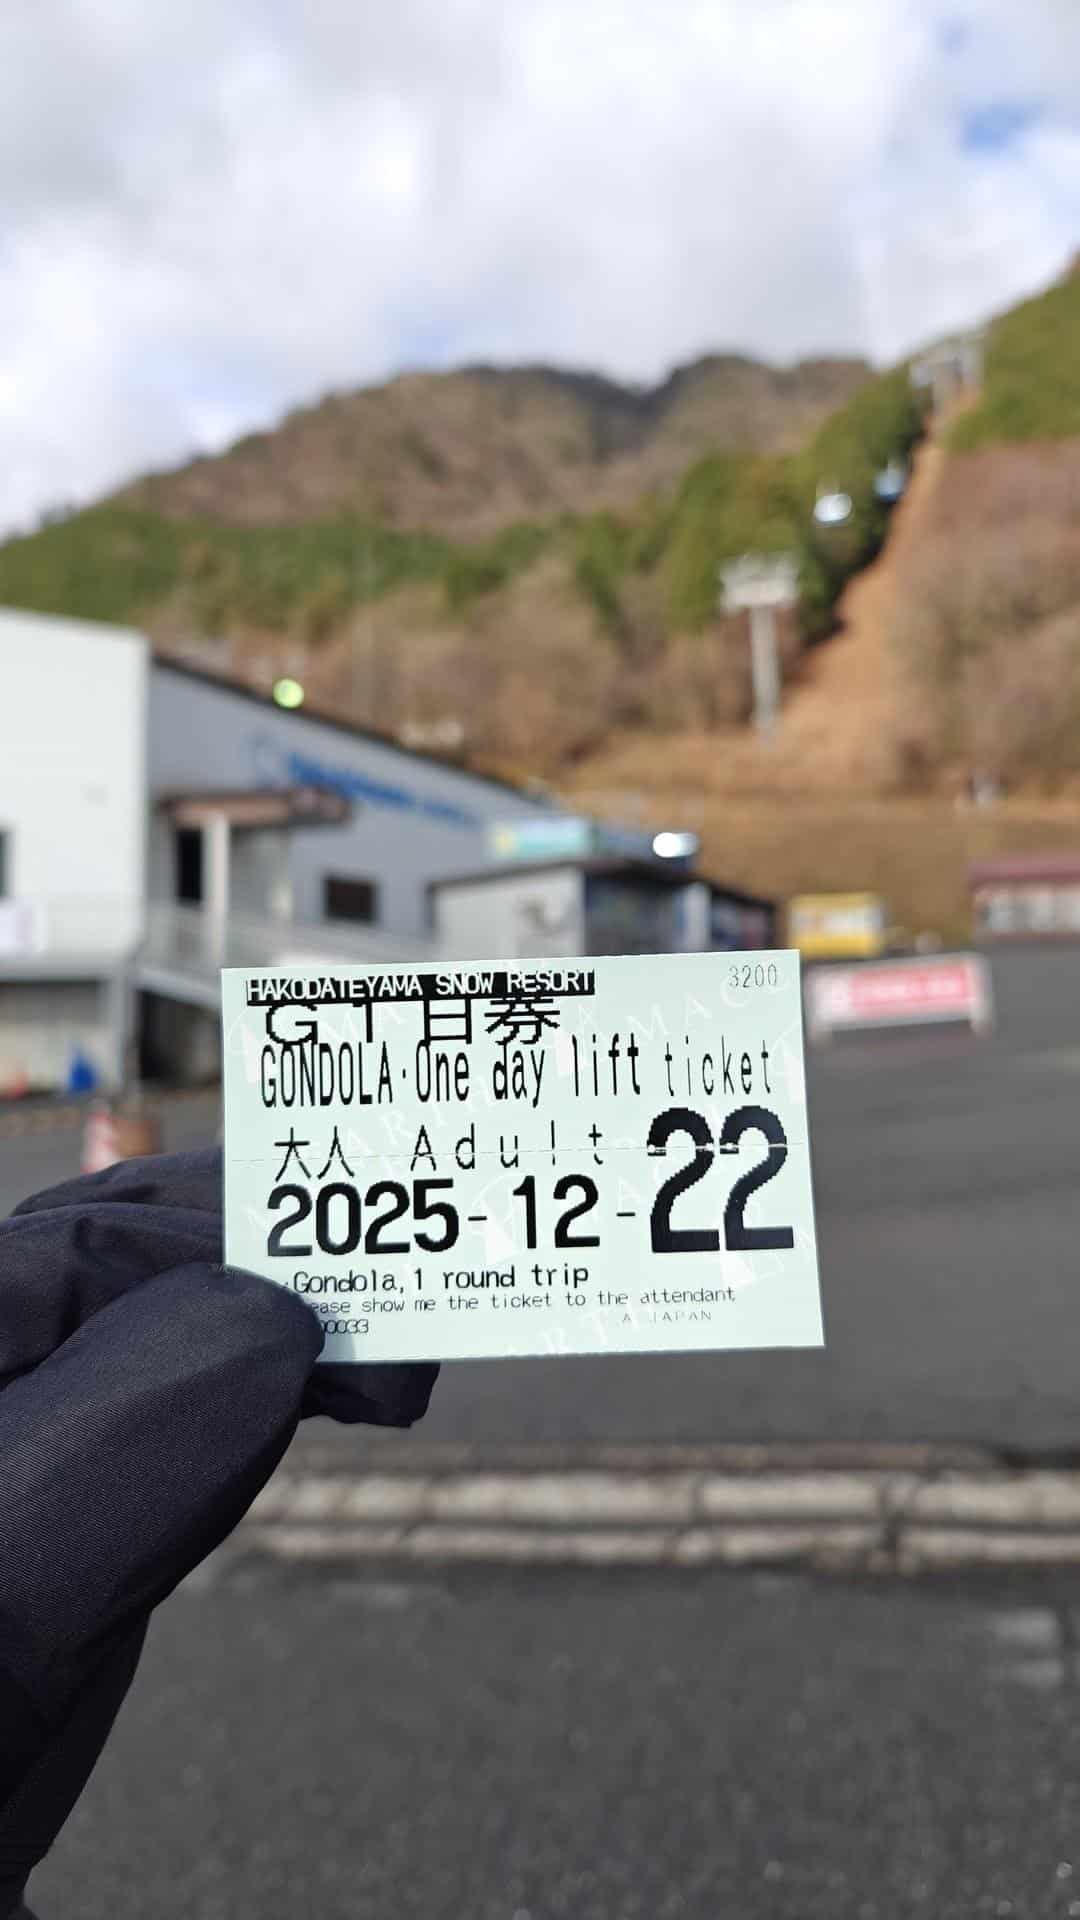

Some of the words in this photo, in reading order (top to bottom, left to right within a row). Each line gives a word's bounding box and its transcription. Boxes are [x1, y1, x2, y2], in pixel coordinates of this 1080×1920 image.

[248, 976, 423, 1001] HAKODATEYAMA
[435, 972, 494, 995] SNOW
[506, 970, 592, 993] RESORT
[729, 963, 778, 989] 3200
[492, 1040, 545, 1108] day
[571, 1032, 641, 1097] lift
[664, 1034, 771, 1097] ticket
[273, 1125, 355, 1183] 大人
[410, 1120, 604, 1172] Adult
[442, 1264, 516, 1290] round
[531, 1262, 590, 1289] trip
[312, 1300, 352, 1314] ease
[361, 1298, 405, 1313] show
[414, 1299, 437, 1312] me
[448, 1295, 480, 1310] the
[491, 1293, 552, 1310] ticket
[565, 1291, 586, 1307] to
[597, 1289, 629, 1305] the
